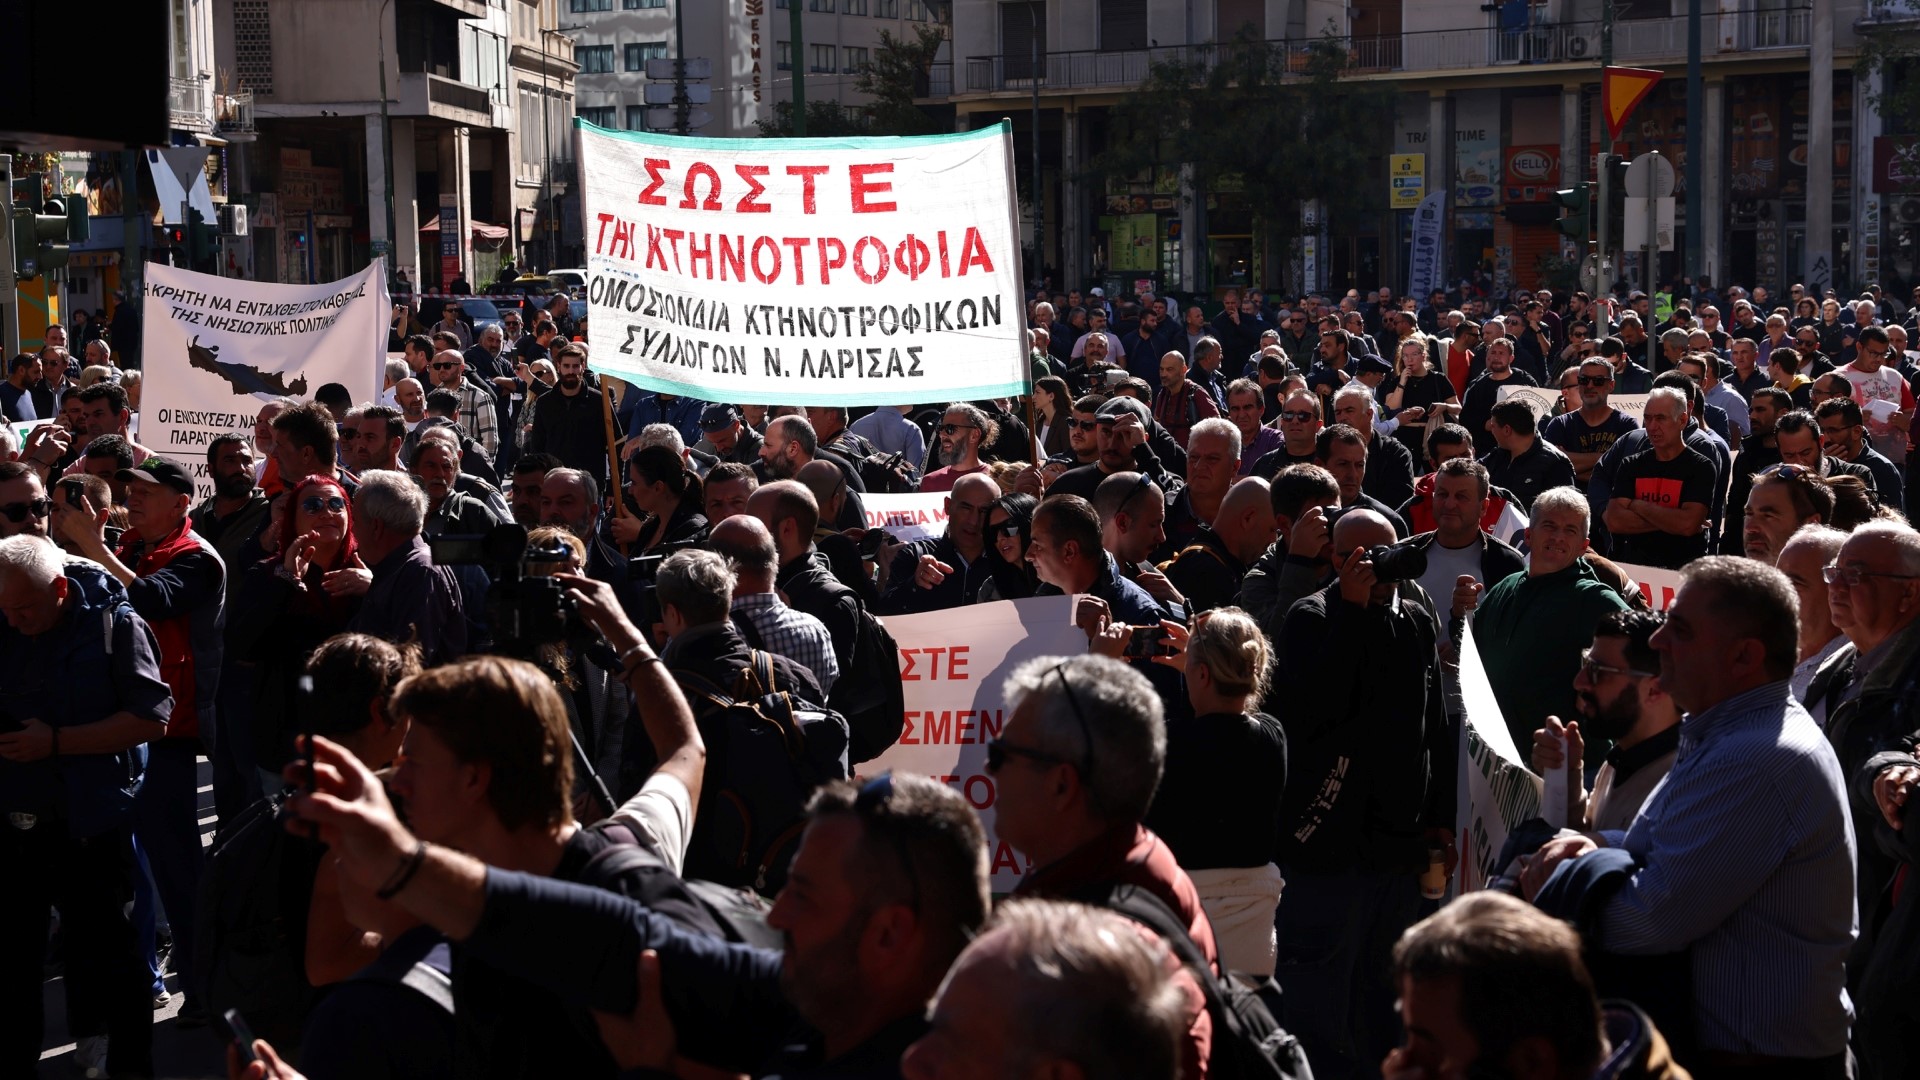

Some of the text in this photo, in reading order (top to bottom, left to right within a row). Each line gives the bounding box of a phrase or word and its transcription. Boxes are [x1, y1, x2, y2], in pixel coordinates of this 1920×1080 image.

[1455, 129, 1486, 141] TIME
[1515, 159, 1549, 169] HELLO
[638, 158, 898, 214] ΣΩΣΤΕ
[645, 223, 995, 285] ΚΤΗΝΟΤΡΟΦΙΑ
[152, 283, 207, 307] ΚΡΗΤΗ
[209, 296, 232, 312] ΝΑ
[235, 300, 301, 317] ΕΝΤΑΧΘΕΙ
[743, 294, 1001, 338] ΚΤΗΝΟΤΡΟΦΙΚΩΝ
[171, 306, 204, 325] ΤΗΣ
[204, 315, 287, 336] ΝΗΣΙΩΤΙΚΗΣ
[619, 324, 924, 379] ΣΥΛΛΟΓΩΝ Ν. ΛΑΡΙΣΑΣ
[158, 408, 257, 429] ΟΙ ΕΝΙΣΧΥΣΕΙΣ ΝΑ
